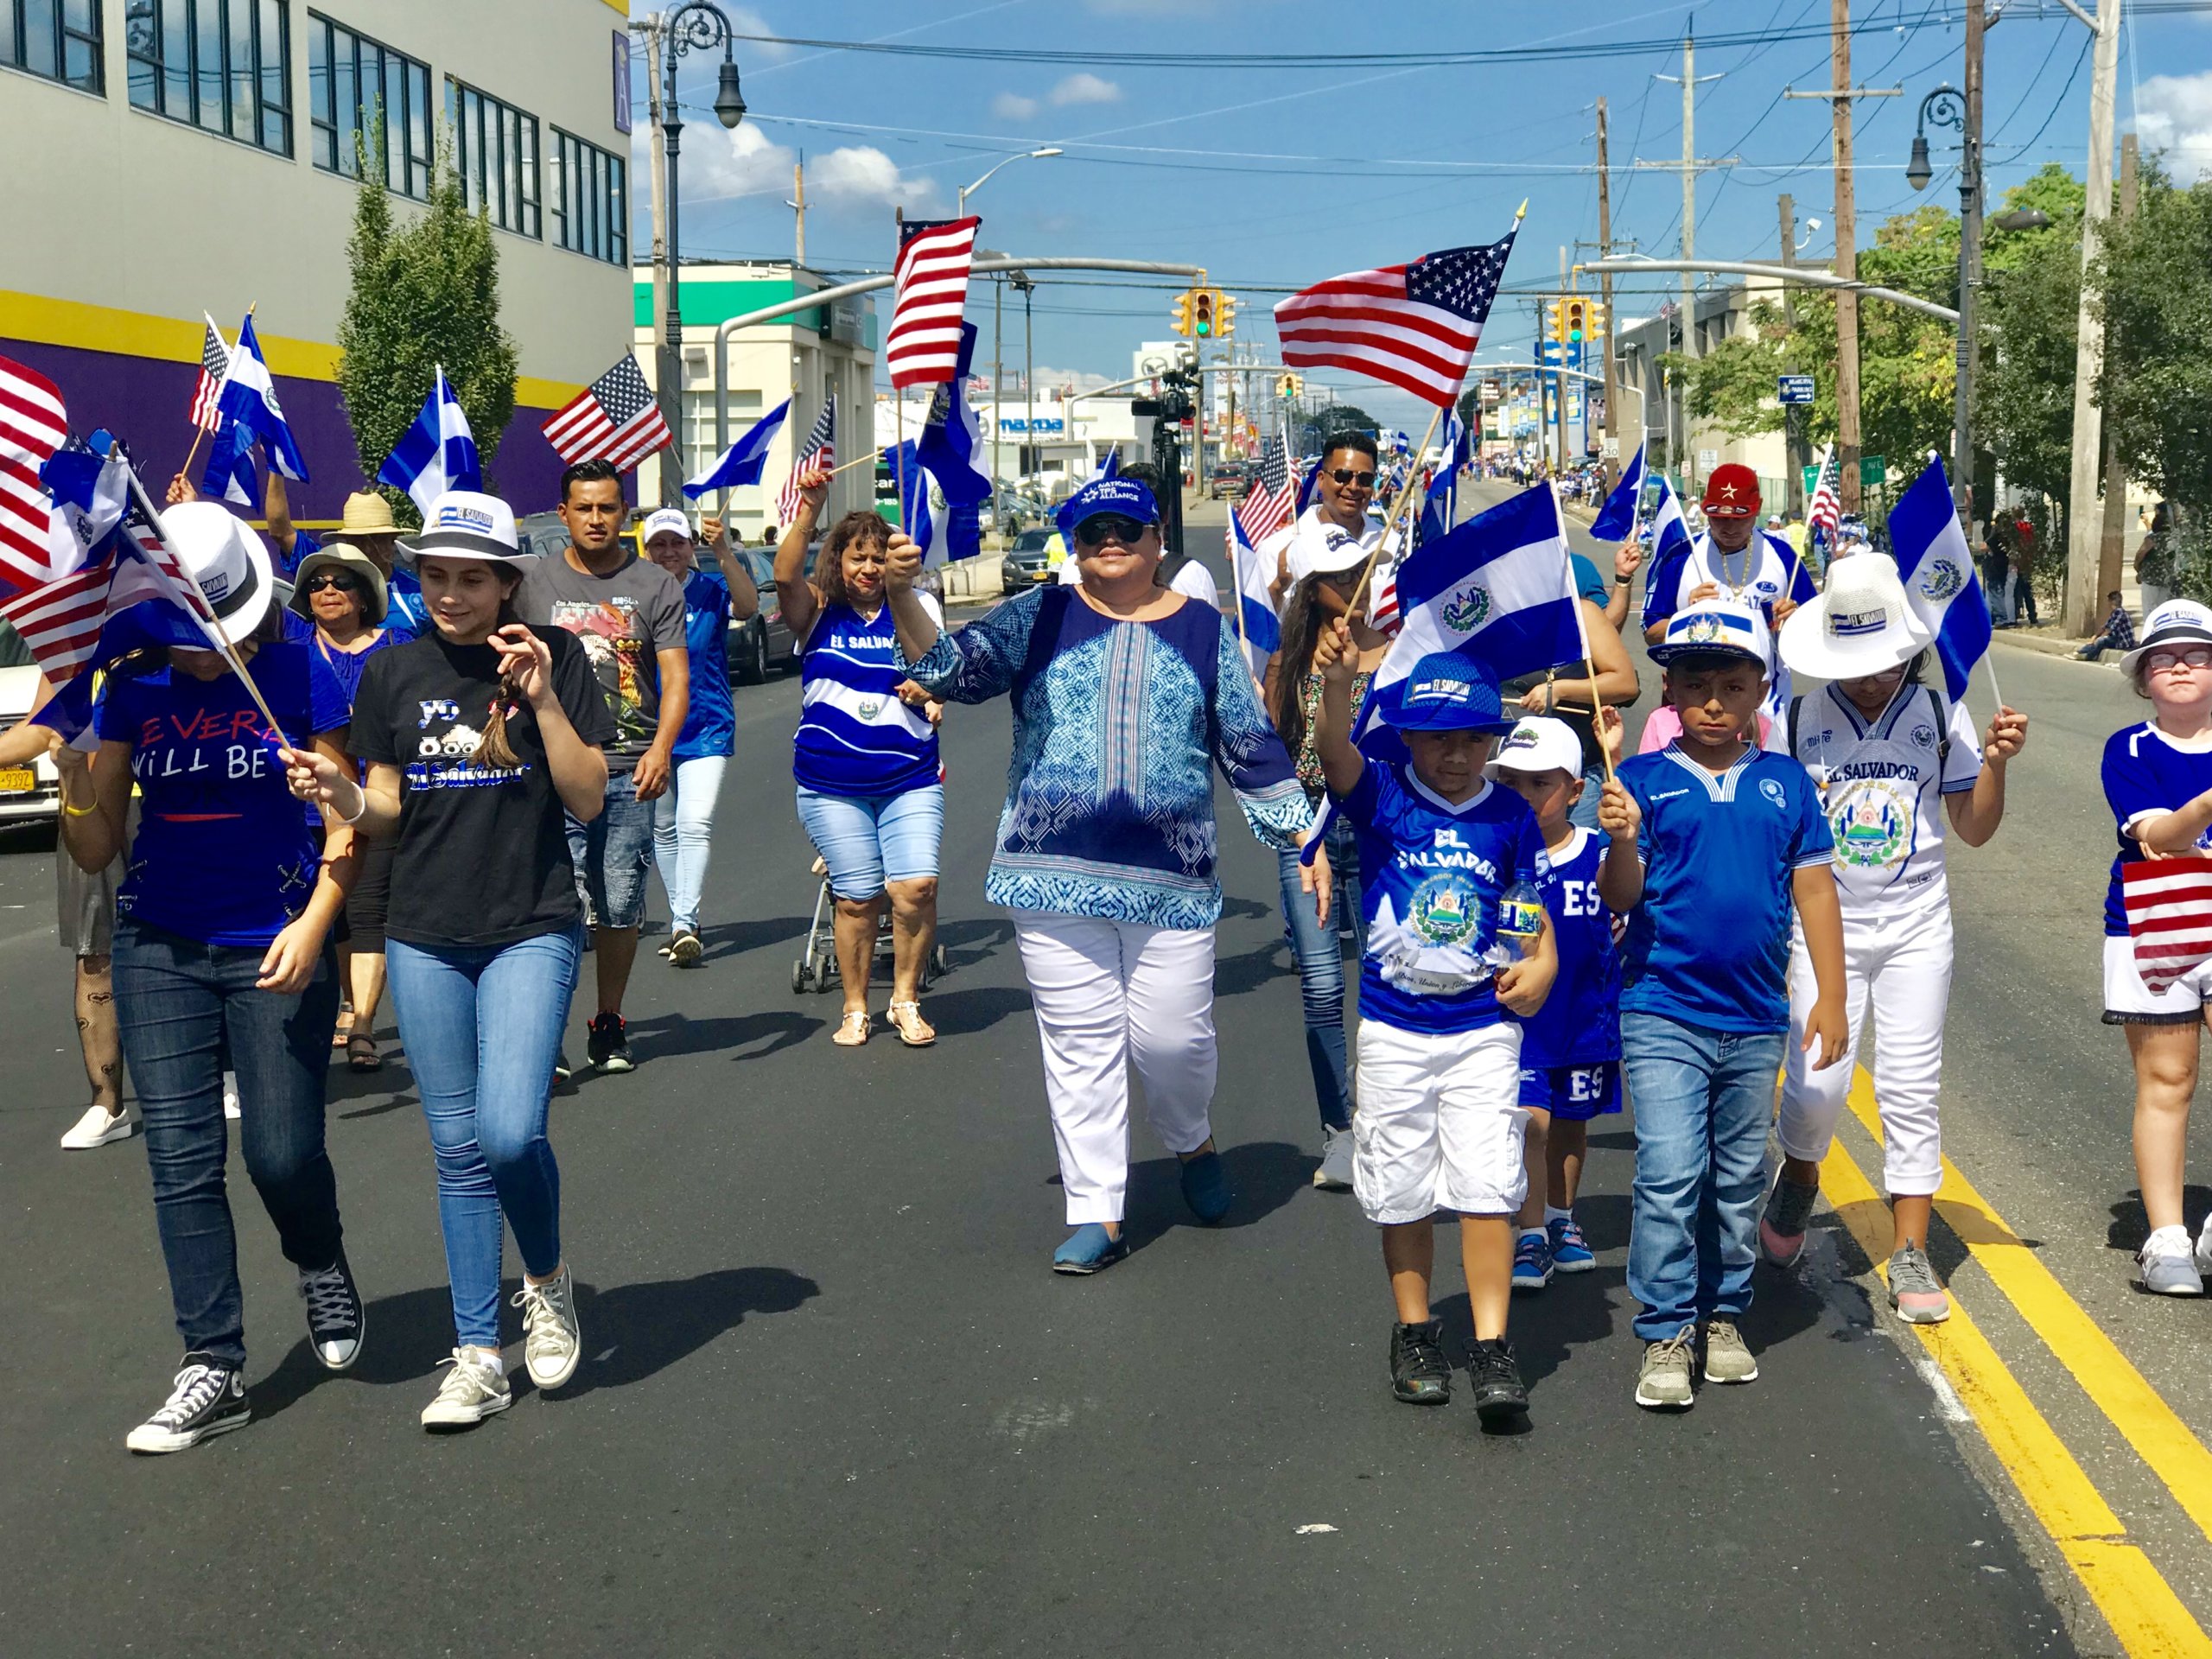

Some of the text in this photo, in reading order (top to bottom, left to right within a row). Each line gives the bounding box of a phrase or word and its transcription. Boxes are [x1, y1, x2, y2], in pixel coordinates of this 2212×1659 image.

[1866, 460, 1883, 469] AVE
[1097, 480, 1141, 491] NATIONAL
[1099, 493, 1139, 502] ALLIANCE
[830, 634, 895, 649] EL SALVA
[226, 744, 269, 779] BE
[1843, 761, 1919, 782] SALVADOR
[1434, 828, 1471, 849] EL
[1397, 850, 1497, 884] SALVADOR
[1562, 880, 1602, 917] ES
[1568, 1065, 1604, 1102] ES
